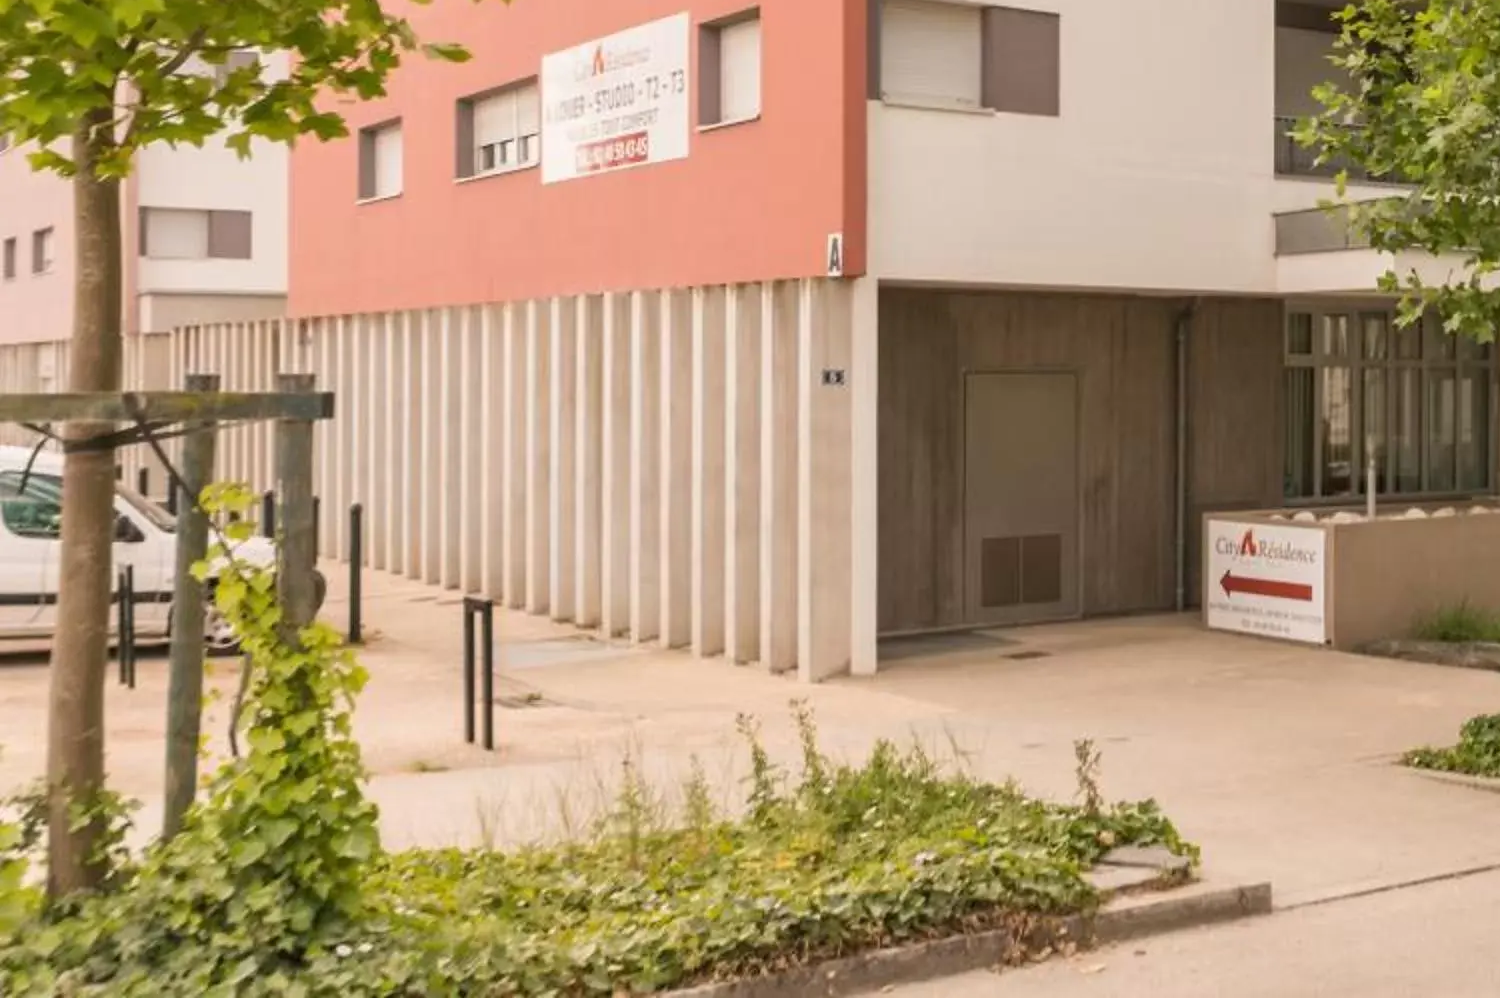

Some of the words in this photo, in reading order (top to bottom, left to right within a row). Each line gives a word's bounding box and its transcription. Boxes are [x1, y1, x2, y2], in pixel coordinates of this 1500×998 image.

[829, 237, 841, 272] A
[1215, 536, 1241, 561] City
[1258, 539, 1317, 563] Résidence
